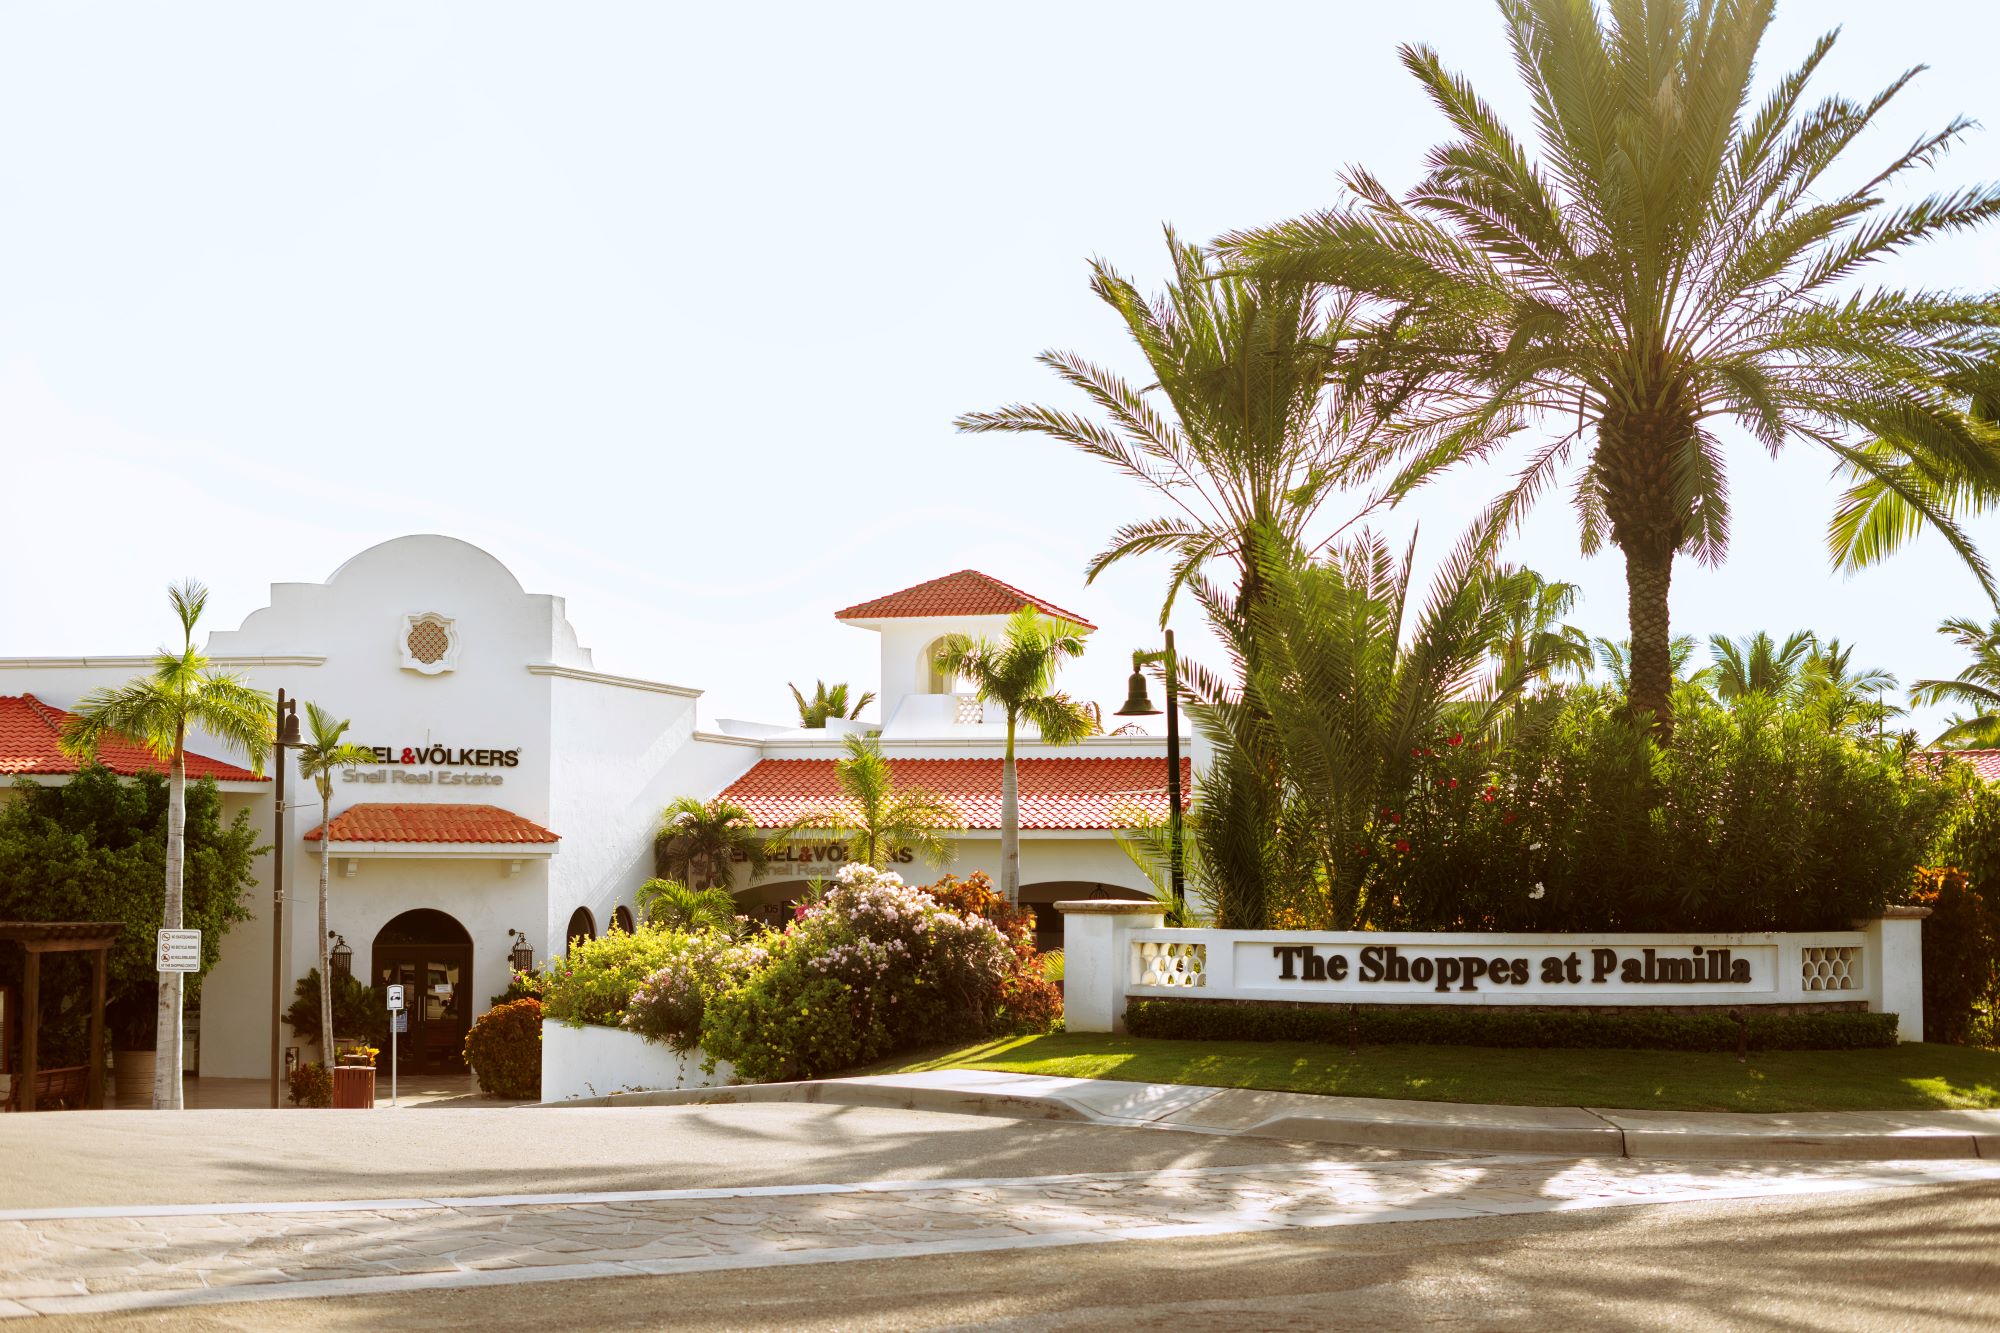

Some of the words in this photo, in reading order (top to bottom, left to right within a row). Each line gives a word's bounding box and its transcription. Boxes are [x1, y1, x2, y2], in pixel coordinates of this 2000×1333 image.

[342, 769, 386, 784] Snell
[392, 770, 433, 784] Real
[438, 771, 503, 786] Estate
[764, 904, 779, 914] 105
[1273, 945, 1348, 982] The
[1358, 945, 1530, 992] Shoppes
[1540, 951, 1582, 984] at
[1591, 946, 1752, 984] Palmilla
